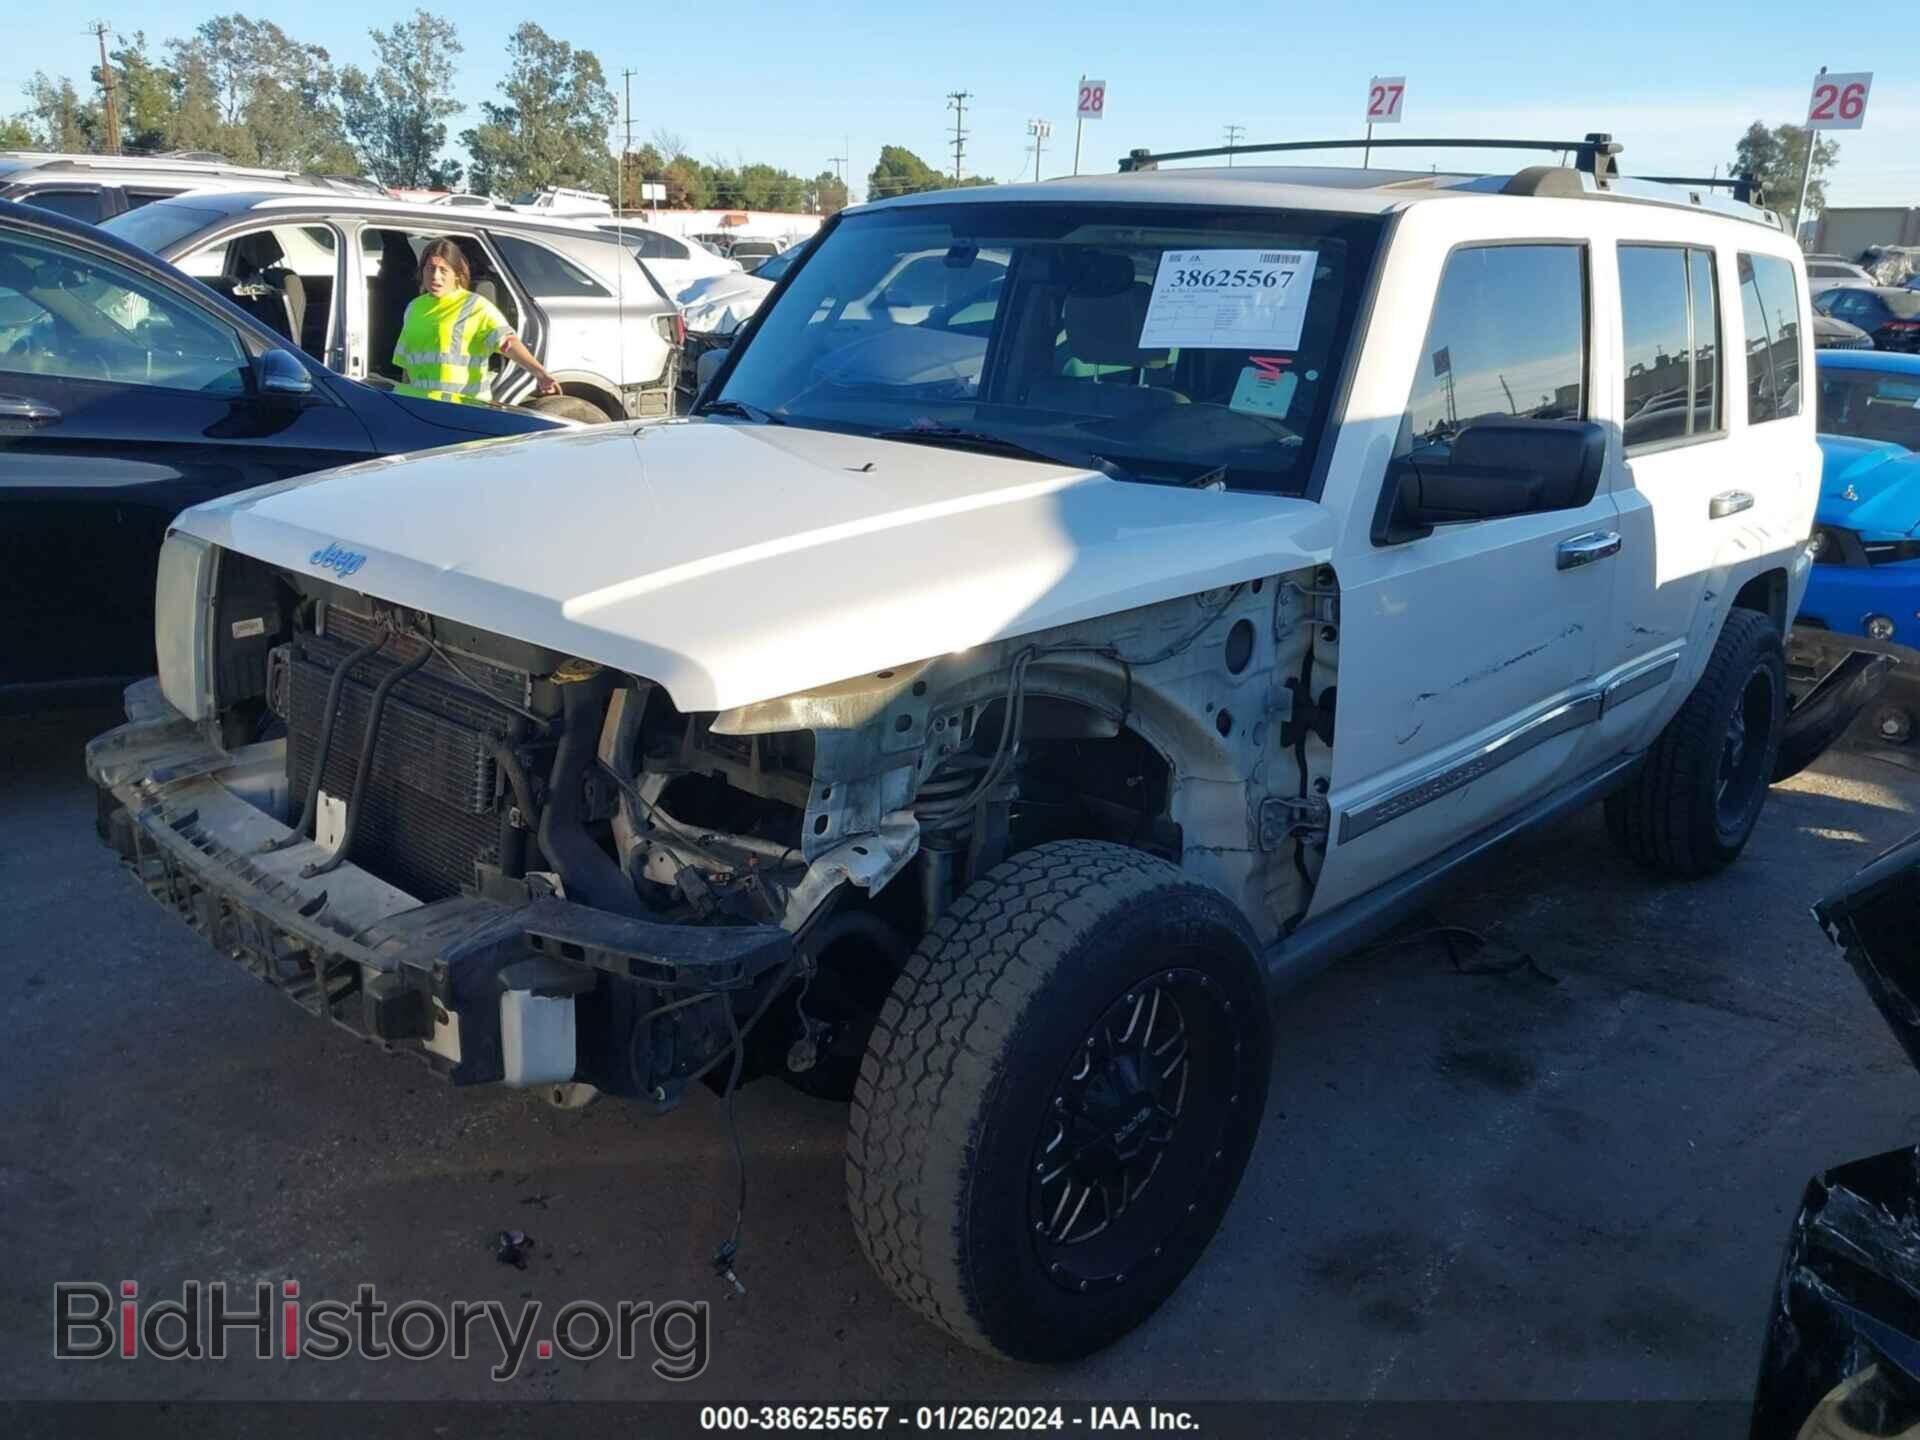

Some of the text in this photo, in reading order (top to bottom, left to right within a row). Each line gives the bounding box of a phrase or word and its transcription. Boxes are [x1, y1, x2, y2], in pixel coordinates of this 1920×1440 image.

[1078, 87, 1104, 112] 28
[1368, 85, 1404, 116] 27
[1810, 83, 1866, 120] 26
[1169, 268, 1295, 289] 38625567
[309, 542, 367, 579] Jeep
